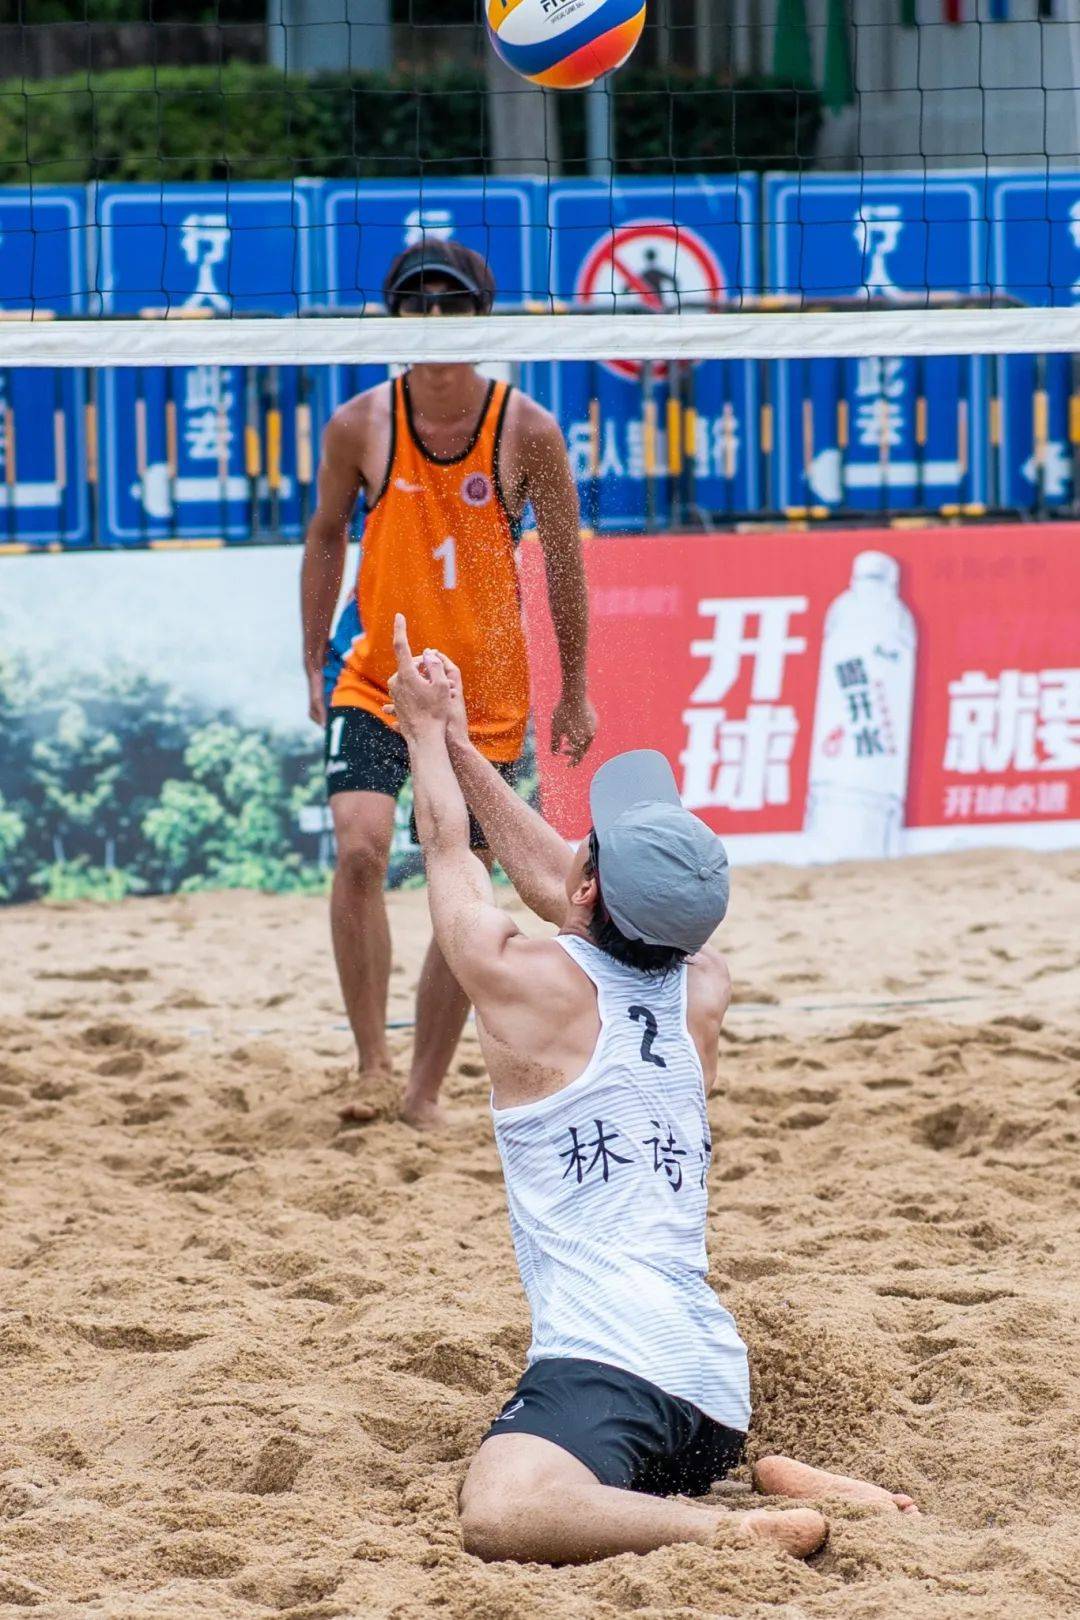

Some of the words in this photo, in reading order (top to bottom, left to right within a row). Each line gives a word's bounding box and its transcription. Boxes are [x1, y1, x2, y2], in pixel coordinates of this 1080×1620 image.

[432, 536, 456, 590] 1
[679, 595, 809, 811] 开球
[329, 715, 345, 757] 1
[626, 1004, 667, 1069] 2
[558, 1118, 713, 1193] 林诗
